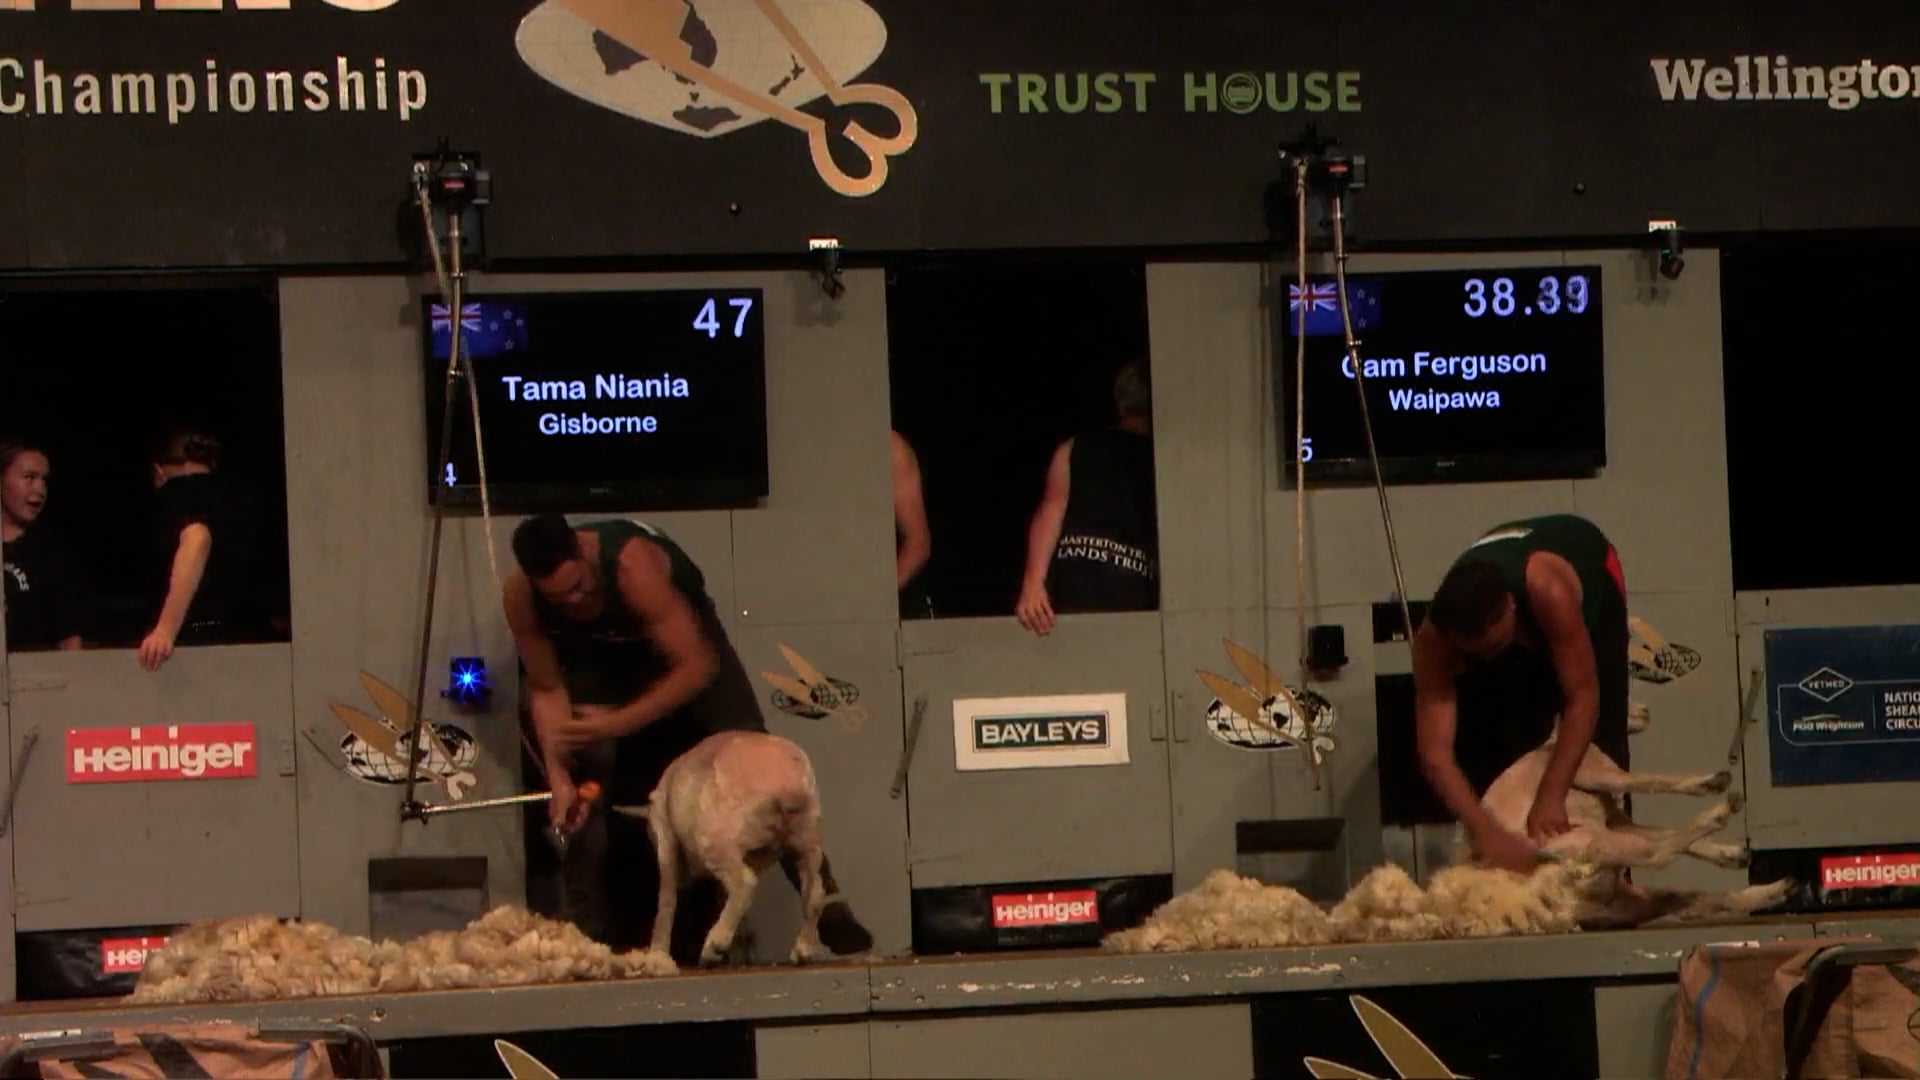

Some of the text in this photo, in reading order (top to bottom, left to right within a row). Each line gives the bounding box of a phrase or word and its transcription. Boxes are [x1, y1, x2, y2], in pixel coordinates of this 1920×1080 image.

[0, 56, 427, 123] Championship
[979, 72, 1362, 115] TRUST HOUSE
[1650, 55, 1920, 110] Wellingto
[692, 298, 753, 338] 47
[1414, 351, 1547, 380] Ferguson
[502, 373, 690, 401] Tama Niania
[1388, 388, 1501, 414] Waipawa
[538, 412, 658, 435] Gisborne
[1057, 546, 1108, 563] LANDS
[1885, 704, 1920, 718] SHEA
[981, 720, 1100, 745] BAYLEYS
[73, 725, 252, 776] Heiniger
[1825, 855, 1920, 884] Heiniger
[996, 892, 1096, 922] Heiniger
